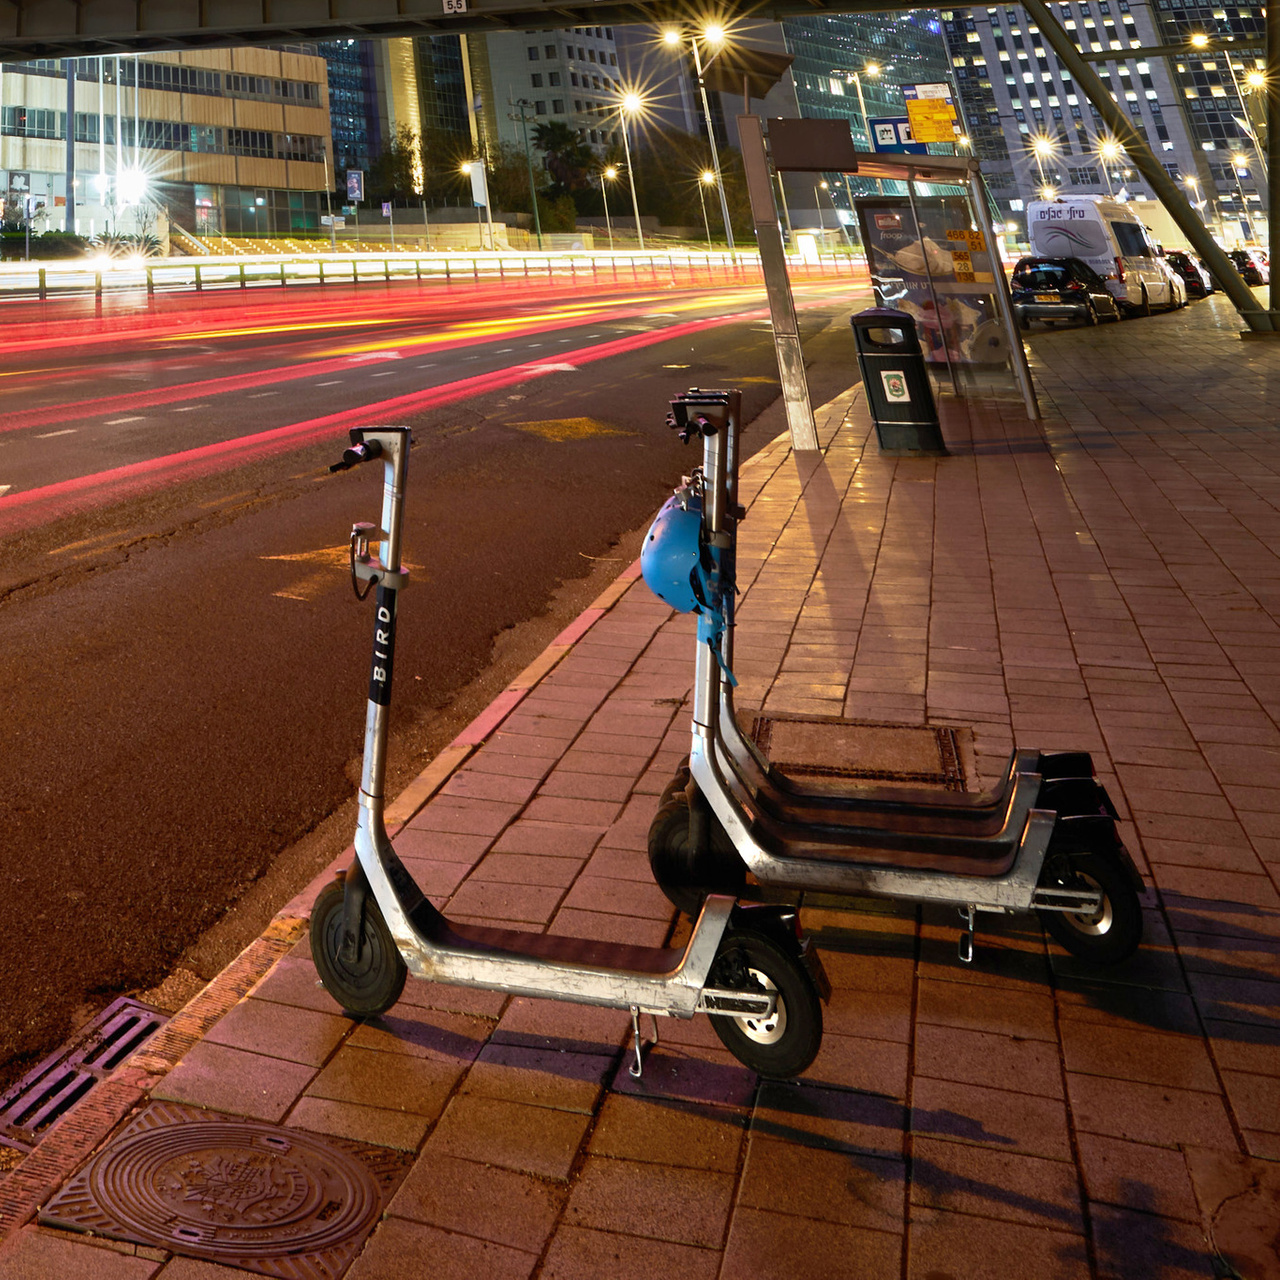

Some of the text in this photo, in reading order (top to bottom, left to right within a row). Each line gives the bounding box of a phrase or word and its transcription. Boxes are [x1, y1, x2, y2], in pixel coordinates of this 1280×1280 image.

[446, 0, 463, 10] 5.5
[968, 231, 980, 240] 82
[970, 241, 982, 250] 51
[953, 251, 969, 260] 565
[957, 262, 969, 271] 28
[373, 606, 391, 682] BIRD
